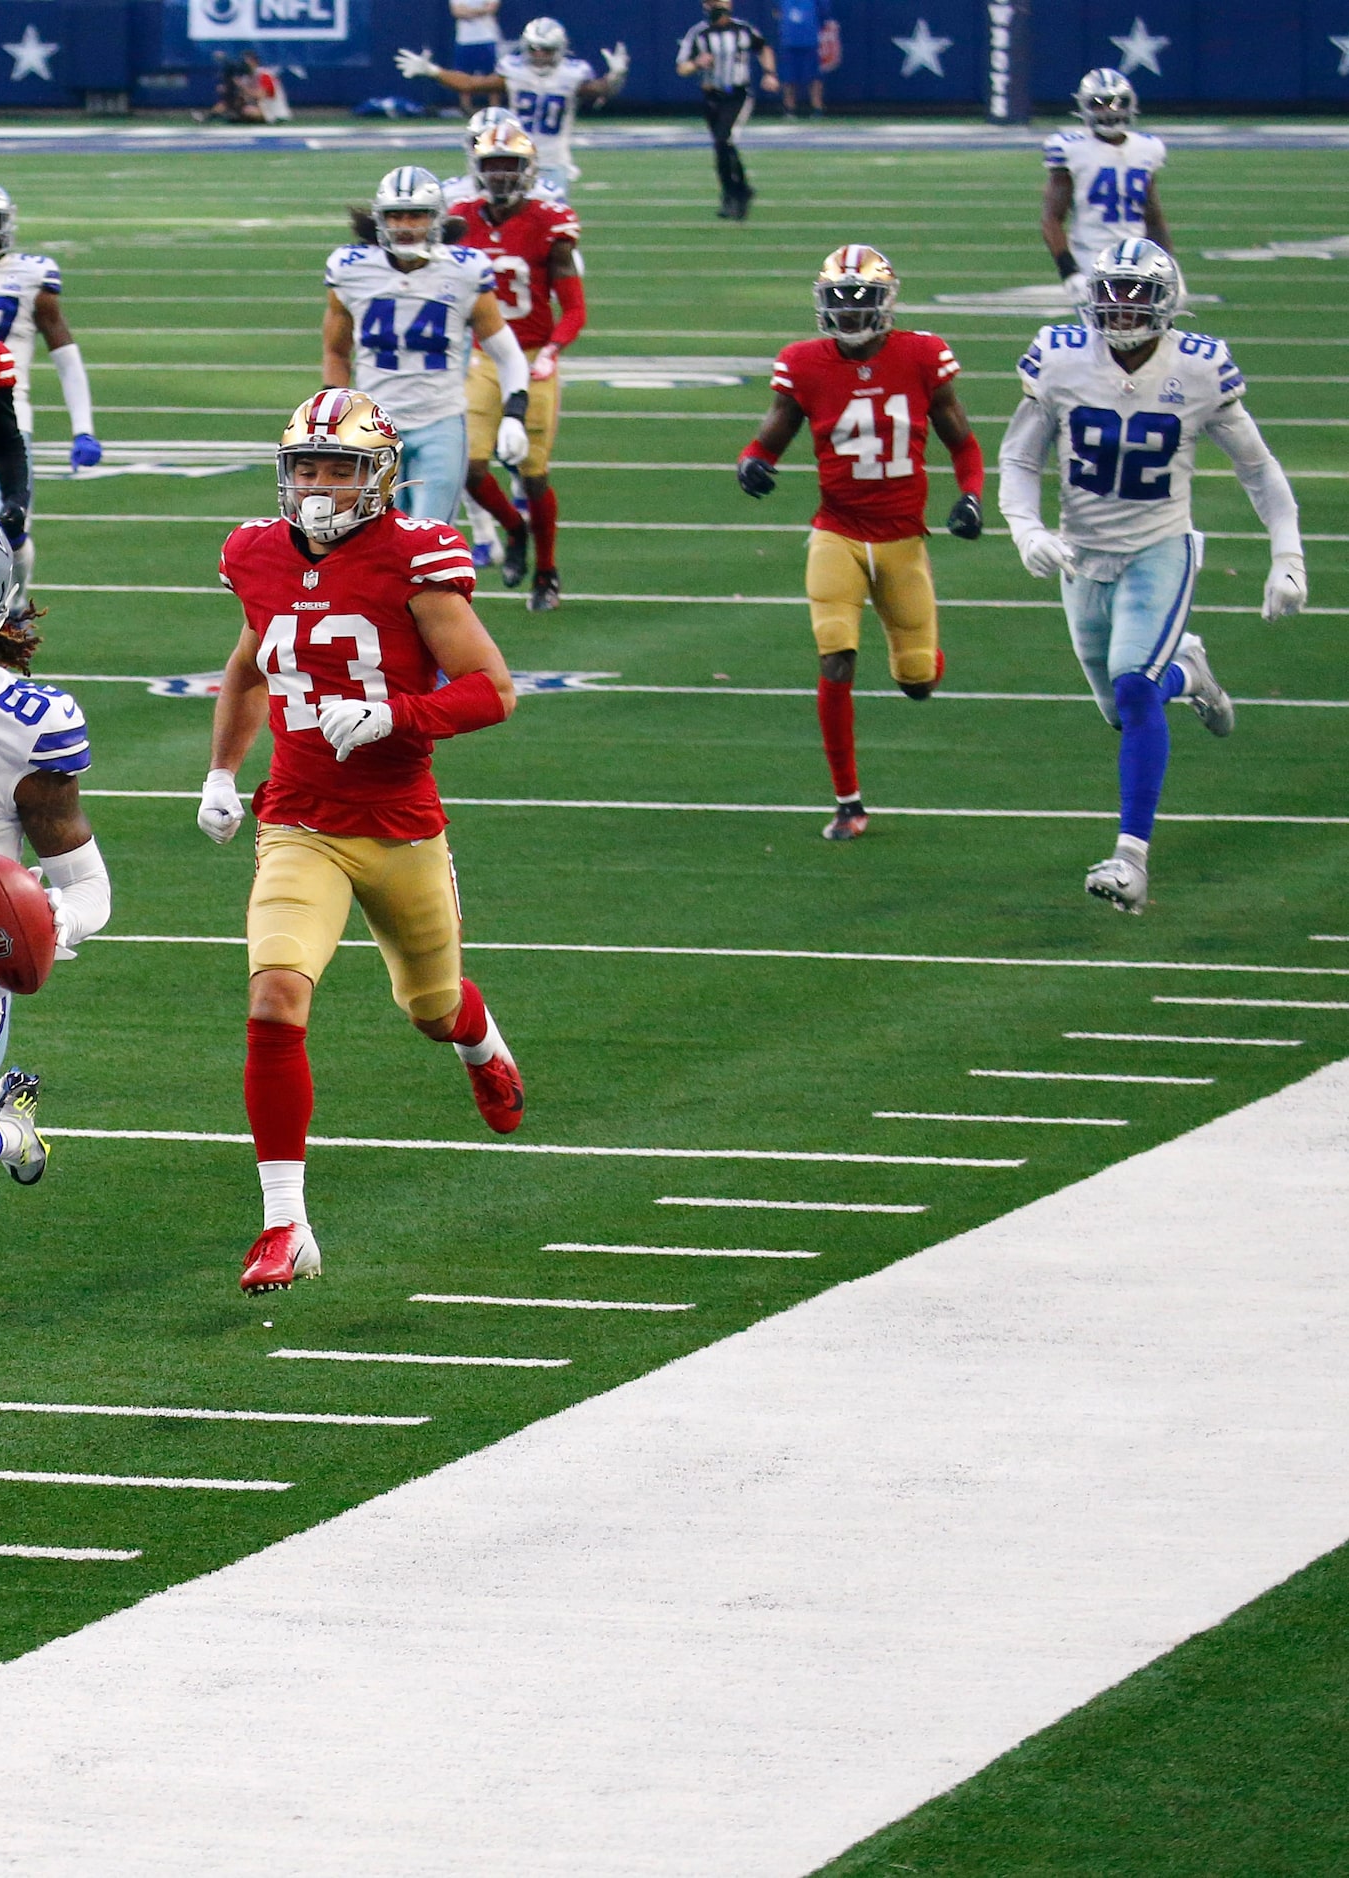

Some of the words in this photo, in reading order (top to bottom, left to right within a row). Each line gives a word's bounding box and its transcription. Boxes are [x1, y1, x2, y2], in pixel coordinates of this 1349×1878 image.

[516, 88, 566, 135] 20
[1088, 166, 1148, 222] 48
[492, 255, 532, 320] 3
[361, 298, 450, 370] 44
[831, 393, 913, 480] 41
[1069, 405, 1181, 500] 92
[291, 601, 330, 610] 49ERS
[256, 614, 388, 731] 43
